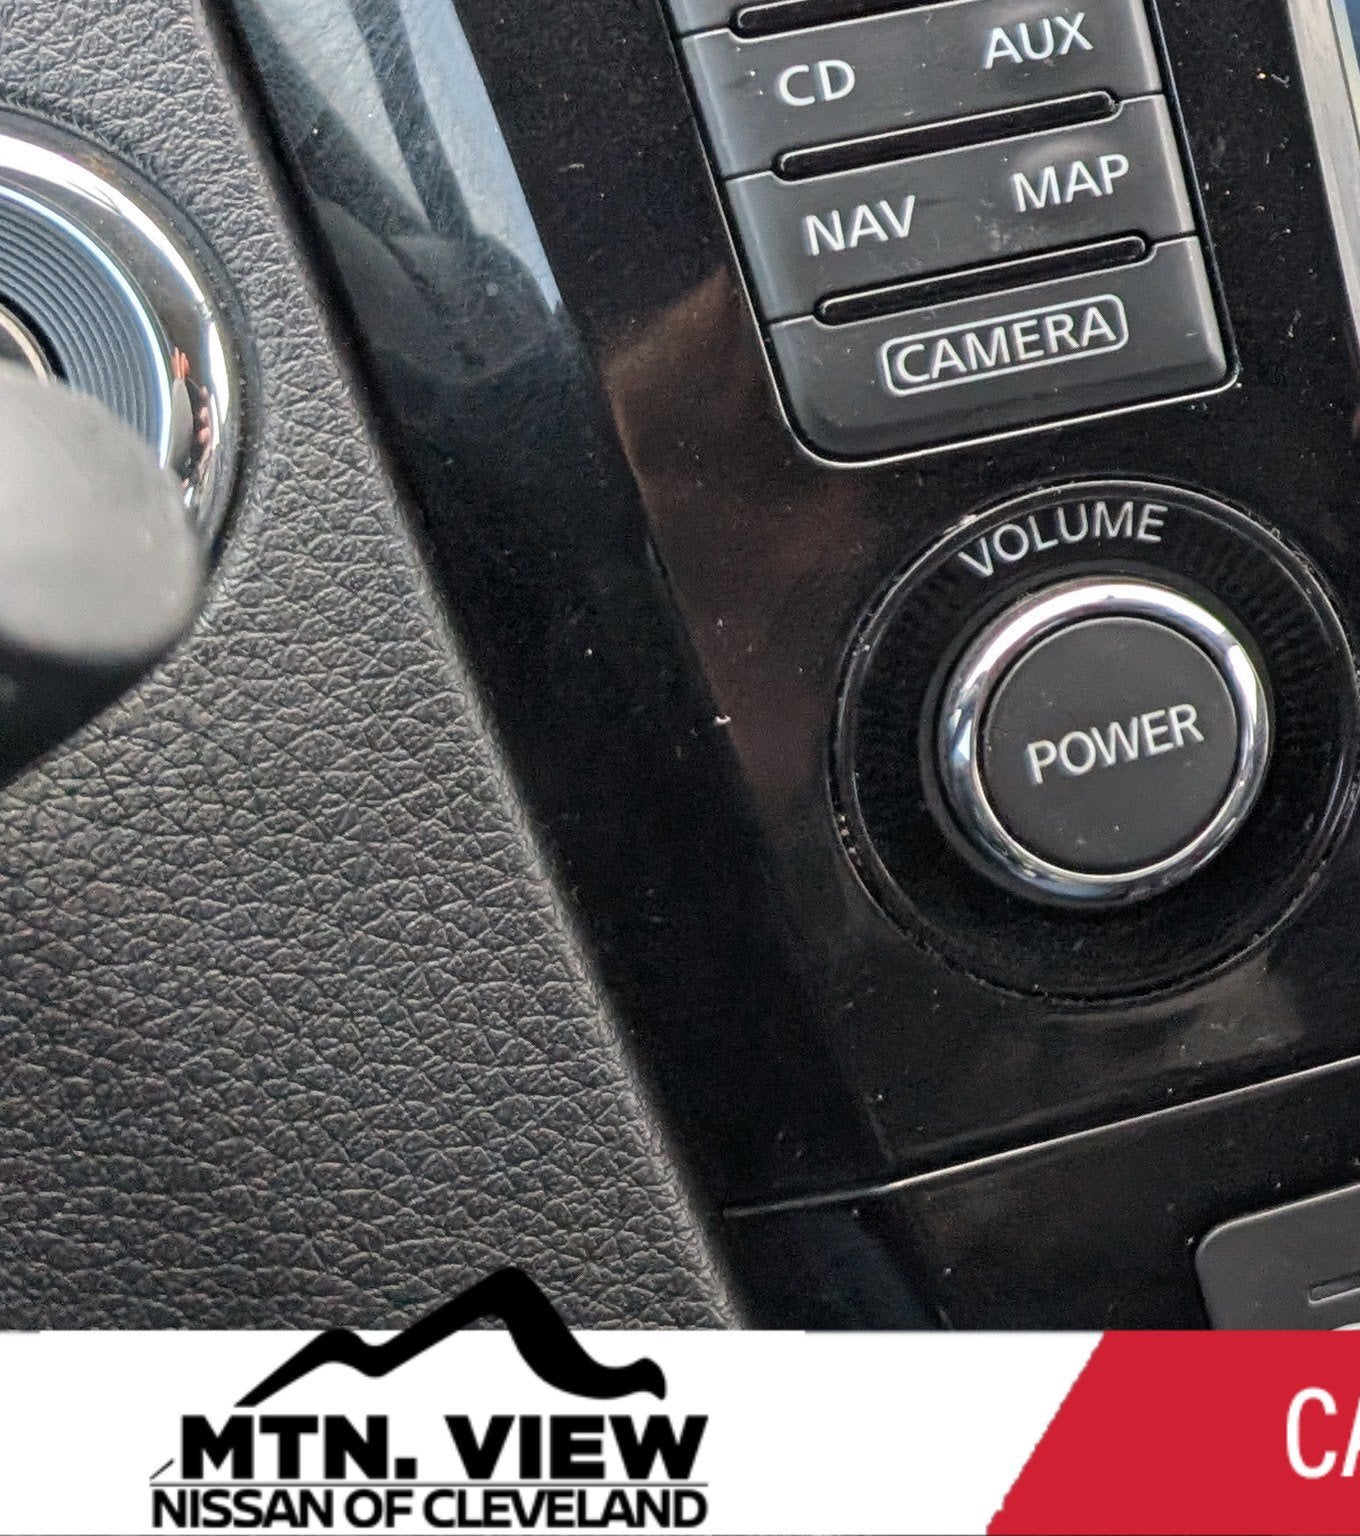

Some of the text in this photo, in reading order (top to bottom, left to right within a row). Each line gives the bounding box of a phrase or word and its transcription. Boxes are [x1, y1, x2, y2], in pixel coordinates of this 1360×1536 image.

[984, 13, 1093, 69] AUX
[779, 60, 855, 106] CD
[1013, 154, 1129, 212] MAP
[806, 196, 915, 255] NAV
[896, 305, 1116, 385] CAMERA
[959, 501, 1167, 578] VOLUME
[1026, 703, 1205, 784] POWER
